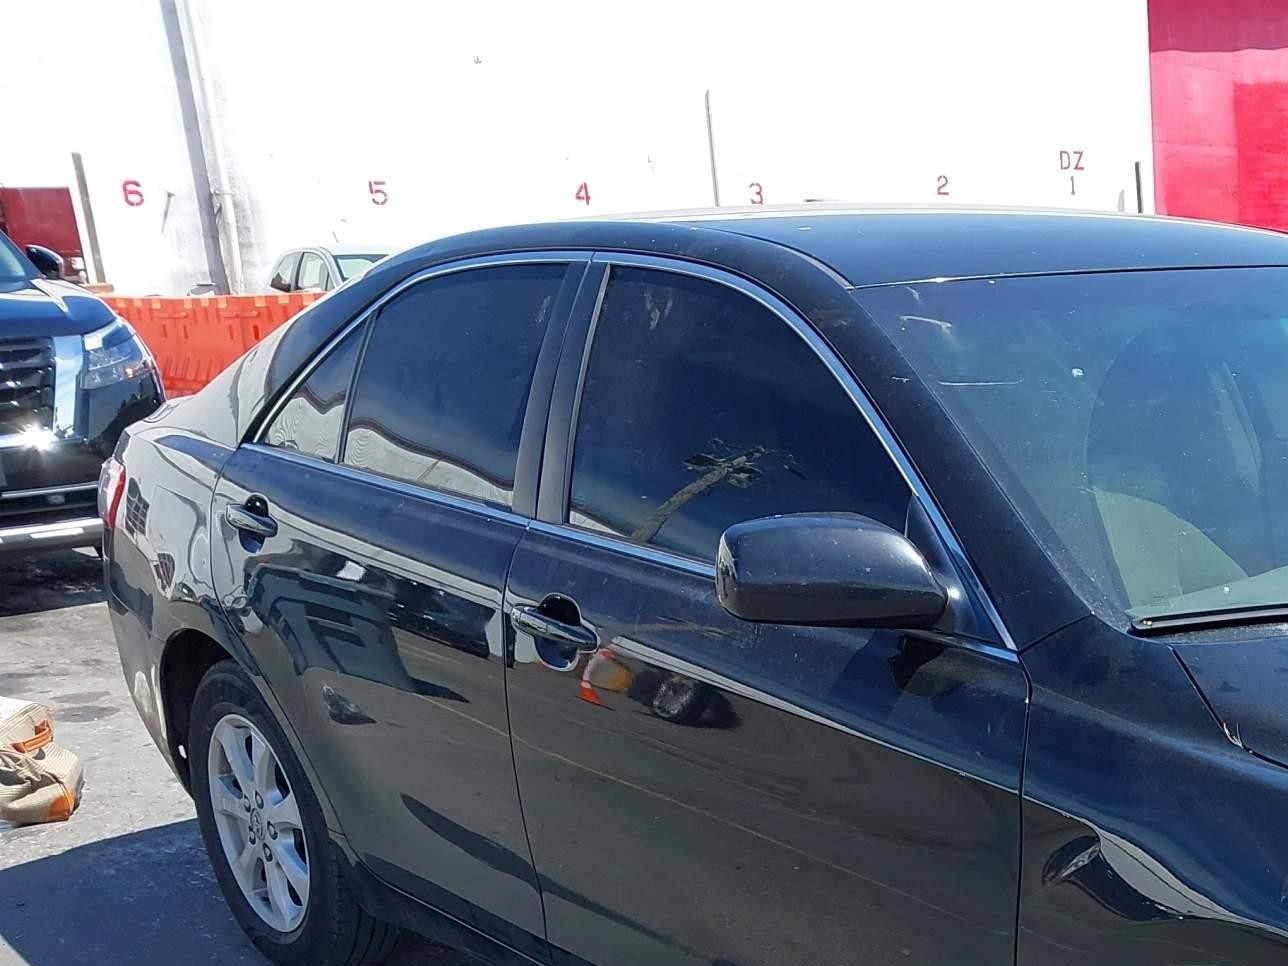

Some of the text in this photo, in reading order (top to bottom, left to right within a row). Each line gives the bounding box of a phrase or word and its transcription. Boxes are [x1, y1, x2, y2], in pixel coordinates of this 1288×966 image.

[1060, 151, 1084, 171] DZ
[122, 180, 144, 206] 6
[369, 180, 388, 206] 5
[575, 182, 591, 206] 4
[748, 183, 764, 206] 3
[936, 175, 949, 196] 2
[1070, 176, 1076, 195] 1
